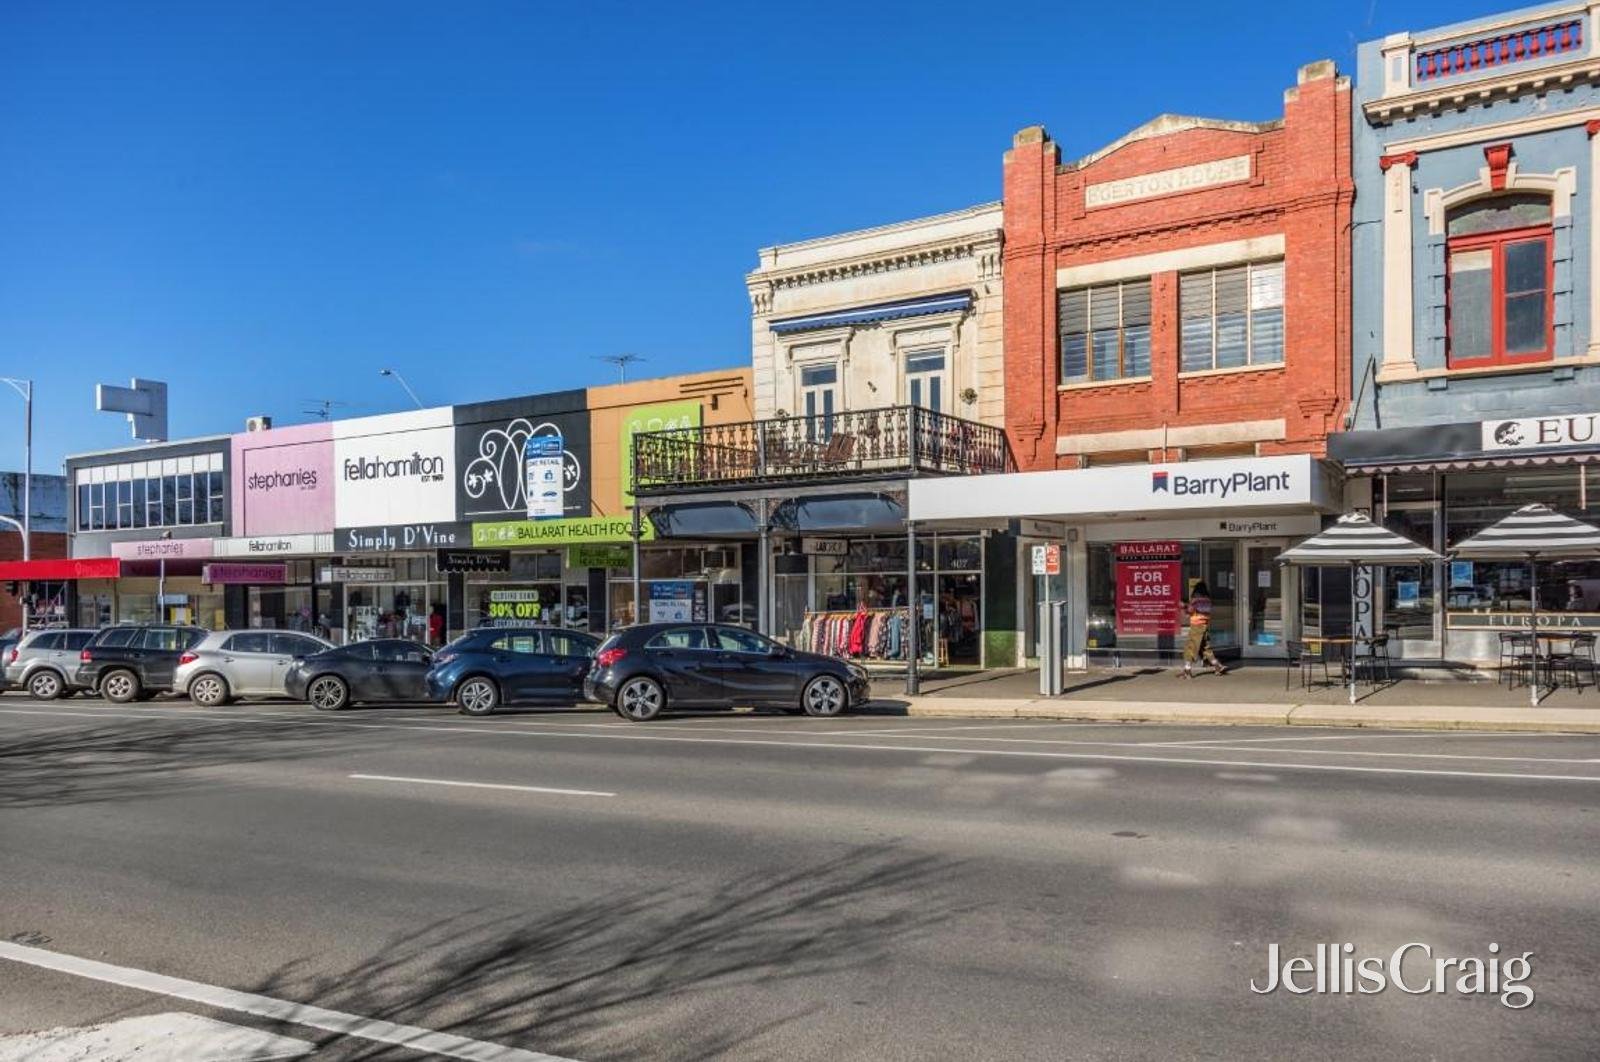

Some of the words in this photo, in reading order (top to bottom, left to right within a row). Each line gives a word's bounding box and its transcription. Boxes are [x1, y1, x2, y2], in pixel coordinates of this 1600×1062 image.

[1536, 416, 1597, 443] EU
[344, 452, 444, 481] fellahamilton
[248, 468, 317, 491] stephanies
[1174, 471, 1290, 498] BarryPlant
[518, 525, 566, 539] BALLARAT
[568, 522, 608, 536] HEALTH
[610, 522, 648, 535] FOOS
[1228, 522, 1277, 532] BarryPlant
[349, 529, 396, 551] Simply
[405, 525, 456, 544] D'Vine
[137, 542, 184, 556] stephanies
[249, 541, 291, 552] fellahamilton
[1120, 545, 1175, 554] BALLARAT
[211, 565, 283, 579] stephanies
[1134, 571, 1162, 582] FOR
[1126, 585, 1171, 596] LEASE
[490, 603, 514, 618] 30%
[516, 603, 541, 618] OFF
[1489, 616, 1580, 626] EUROPA
